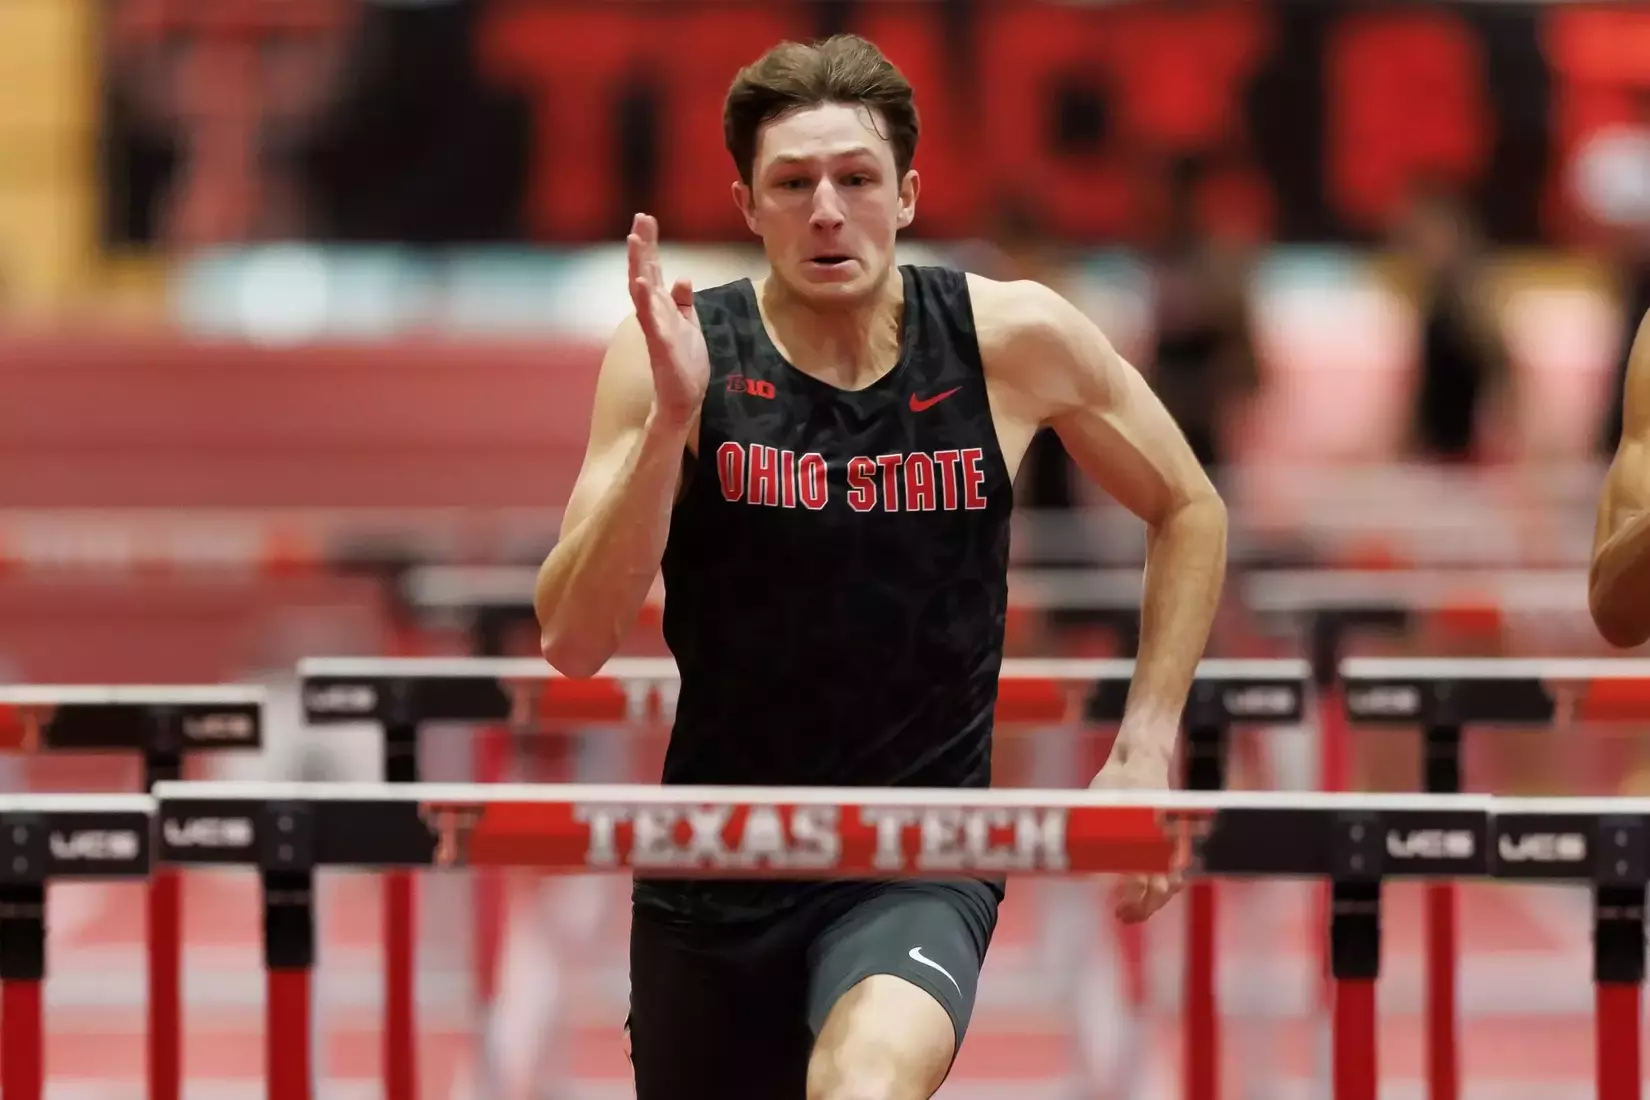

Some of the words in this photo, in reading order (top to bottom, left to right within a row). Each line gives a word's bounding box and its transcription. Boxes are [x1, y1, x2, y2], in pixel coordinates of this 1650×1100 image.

[716, 442, 828, 510] OHIO
[847, 447, 988, 512] STATE
[573, 800, 840, 869] TEXAS
[859, 803, 1068, 870] TECH
